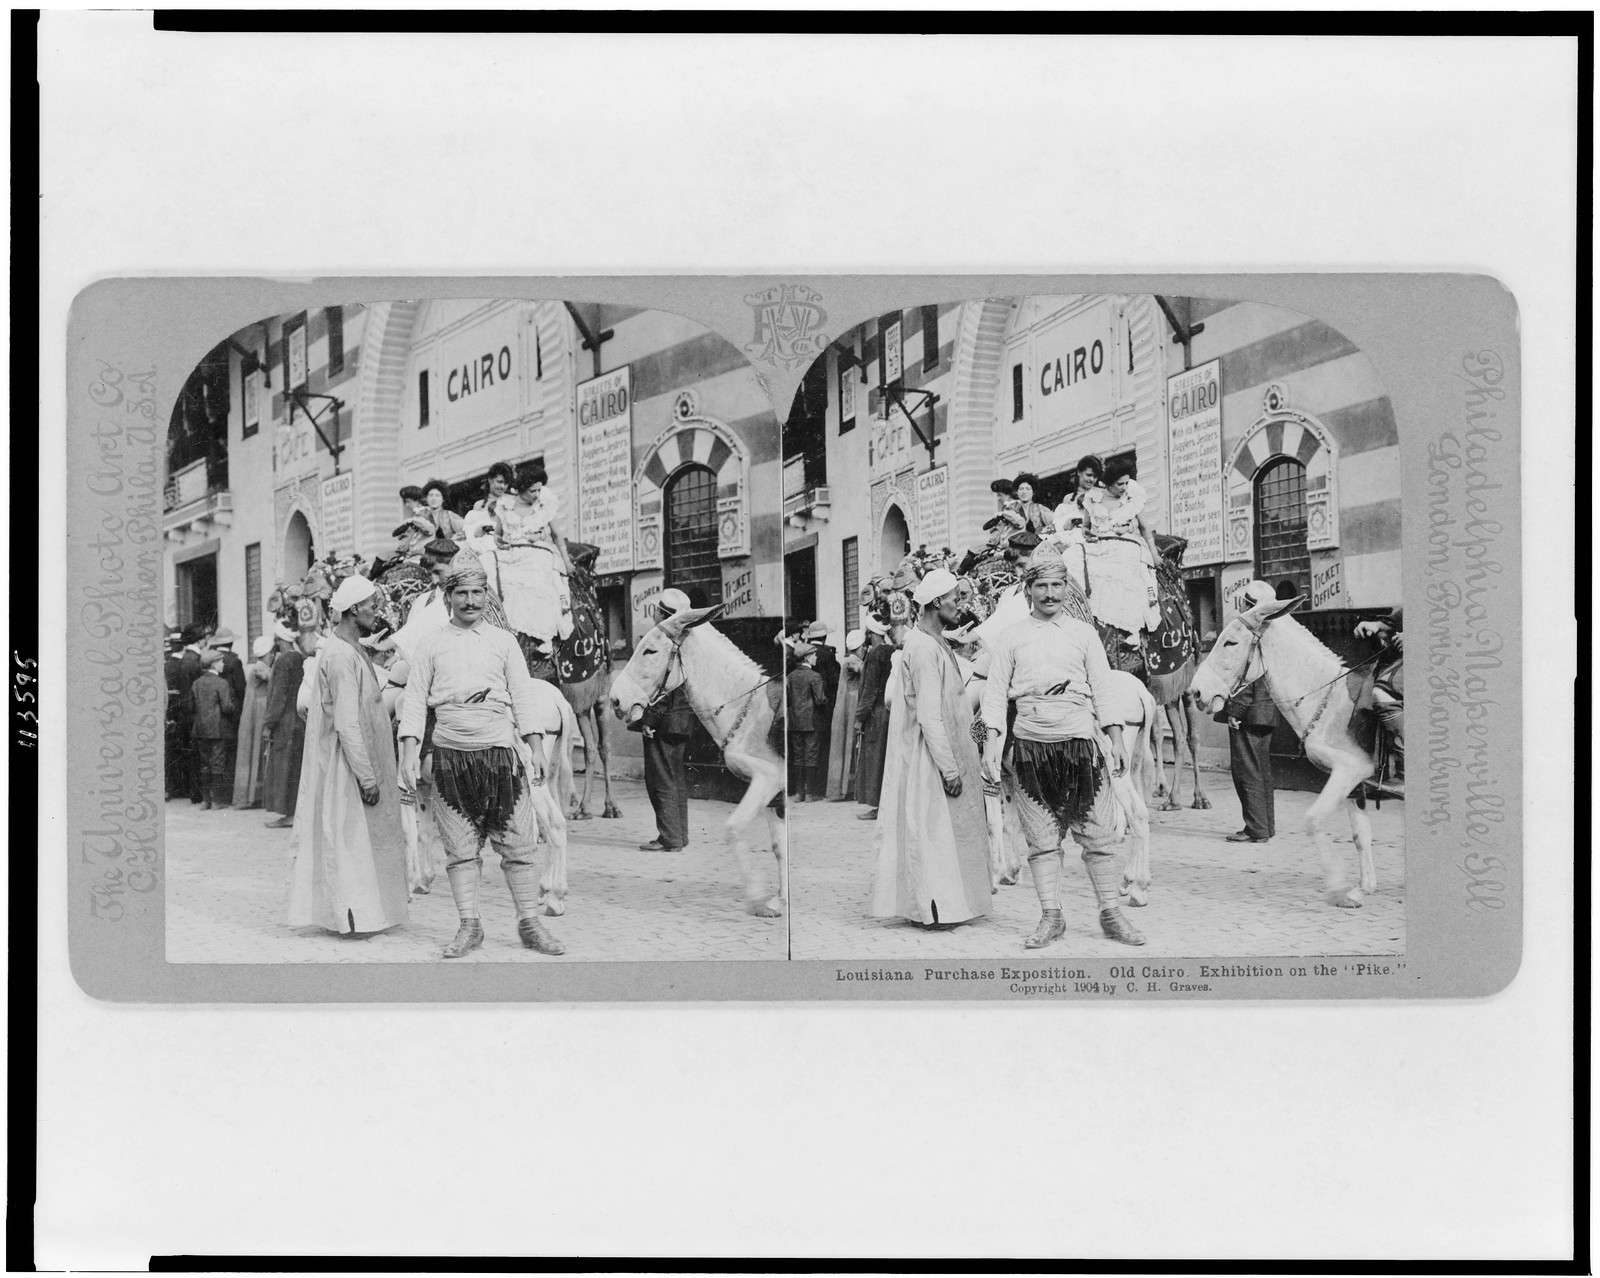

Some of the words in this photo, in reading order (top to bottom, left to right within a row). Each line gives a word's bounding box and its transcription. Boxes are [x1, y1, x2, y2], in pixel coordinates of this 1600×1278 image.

[447, 345, 511, 402] CAIRO
[1040, 338, 1104, 396] CAIRO
[1174, 371, 1202, 391] STREETS
[580, 387, 627, 428] CAIRO
[1171, 380, 1218, 421] CAIRO
[86, 420, 124, 496] Art
[324, 477, 350, 496] CAIRO
[920, 471, 945, 490] CAIRO
[81, 507, 125, 638] Photo
[724, 571, 752, 599] TICKET
[1313, 563, 1341, 590] TICKET
[632, 586, 660, 612] CHILDREN
[724, 589, 752, 616] OFFICE
[1223, 578, 1251, 604] CHILDREN
[1313, 581, 1341, 607] OFFICE
[82, 648, 124, 864] Universal
[88, 868, 124, 922] The
[835, 969, 914, 982] Louisiana
[924, 968, 995, 981] Purchase
[1000, 966, 1091, 984] Exposition.
[1109, 966, 1135, 979] Old
[1141, 965, 1189, 978] Cairo.
[1200, 965, 1284, 978] Exhibition
[1289, 967, 1307, 977] on
[1313, 964, 1338, 977] the
[1010, 983, 1067, 996] Copyright
[1073, 982, 1100, 994] 1904
[1102, 982, 1116, 995] by
[1126, 983, 1138, 993] C.
[1147, 982, 1161, 992] H.
[1169, 982, 1212, 993] Graves.
